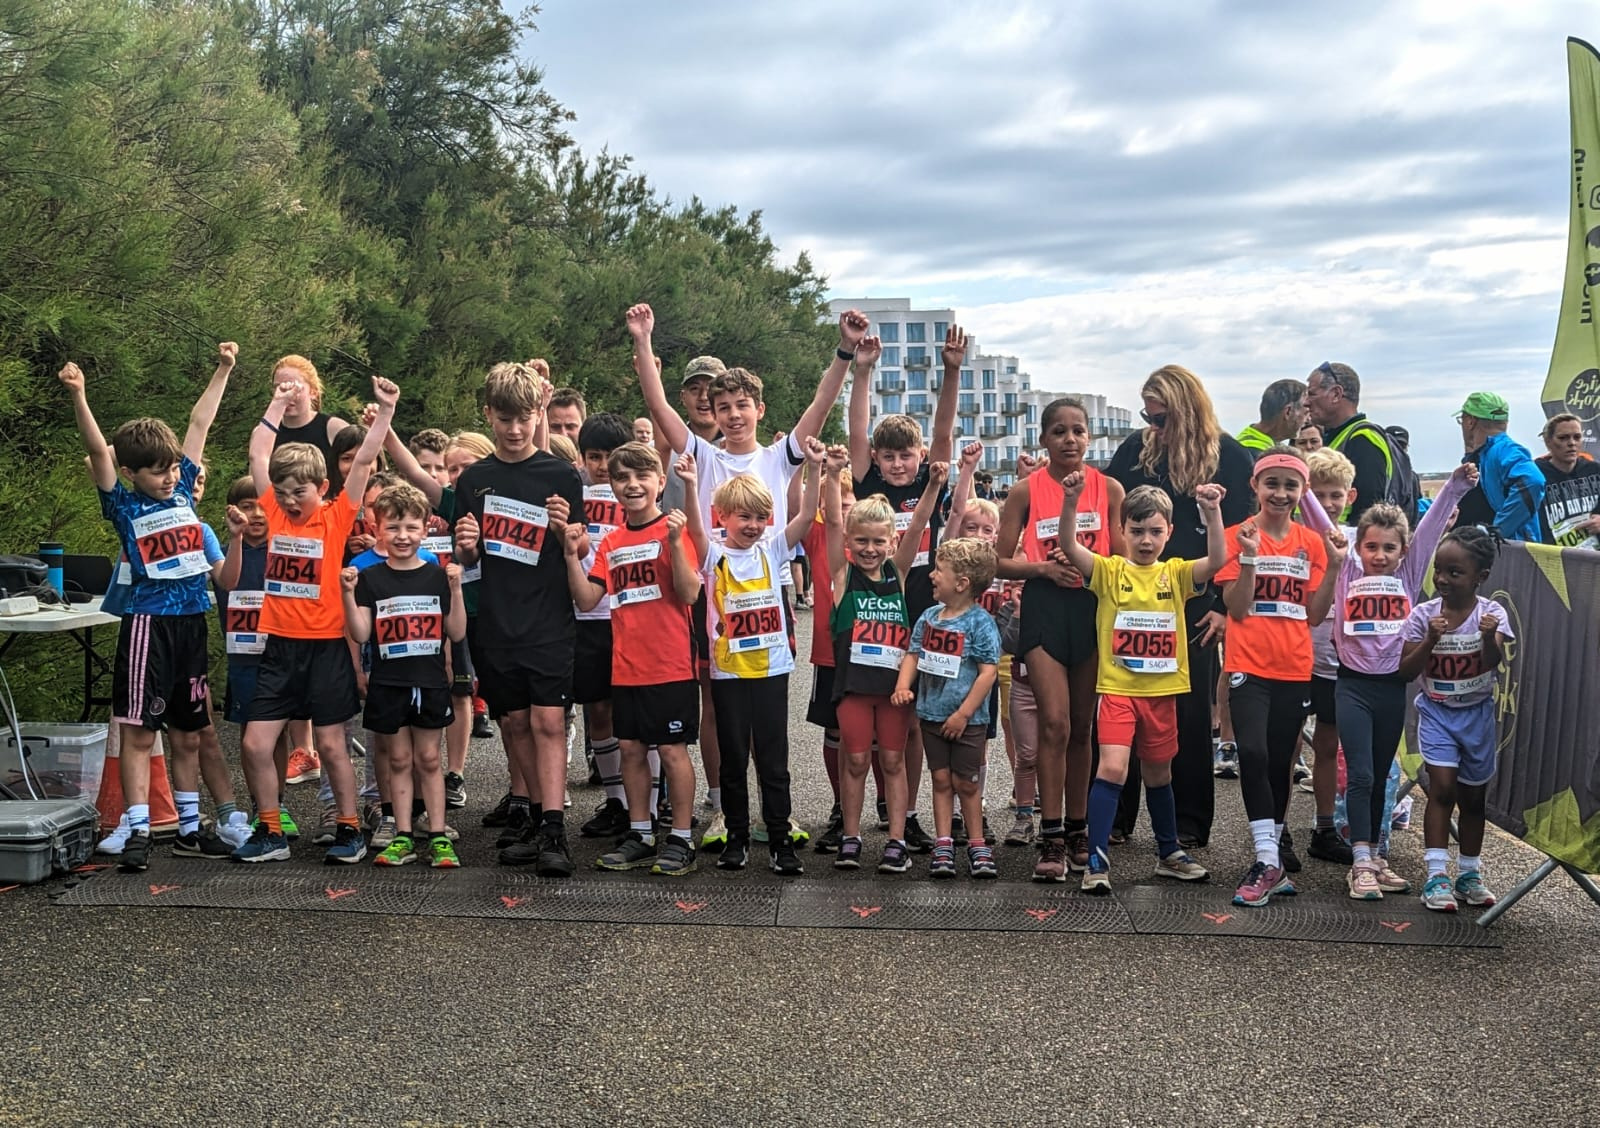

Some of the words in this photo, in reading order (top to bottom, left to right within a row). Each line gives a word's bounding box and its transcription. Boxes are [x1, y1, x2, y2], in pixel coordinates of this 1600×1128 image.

[490, 501, 519, 511] Folkestone
[493, 506, 520, 517] Children's
[140, 515, 174, 528] Folkestone
[147, 518, 177, 531] Children's
[484, 515, 539, 549] 2044
[143, 526, 199, 561] 2052
[184, 553, 200, 562] SAGA
[505, 547, 528, 559] SAGA
[285, 585, 310, 595] SAGA
[631, 589, 655, 598] SAGA
[1254, 576, 1303, 603] 2045
[730, 596, 761, 605] Folkestone
[1282, 605, 1299, 614] SAGA
[1349, 595, 1405, 621] 2003
[231, 610, 260, 631] 20
[730, 608, 779, 637] 2058
[380, 615, 437, 642] 2032
[763, 636, 779, 644] SAGA
[857, 621, 909, 651] 2012
[412, 643, 433, 651] SAGA
[1117, 631, 1172, 656] 2055
[927, 652, 951, 665] SAGA
[1460, 678, 1483, 690] SAGA
